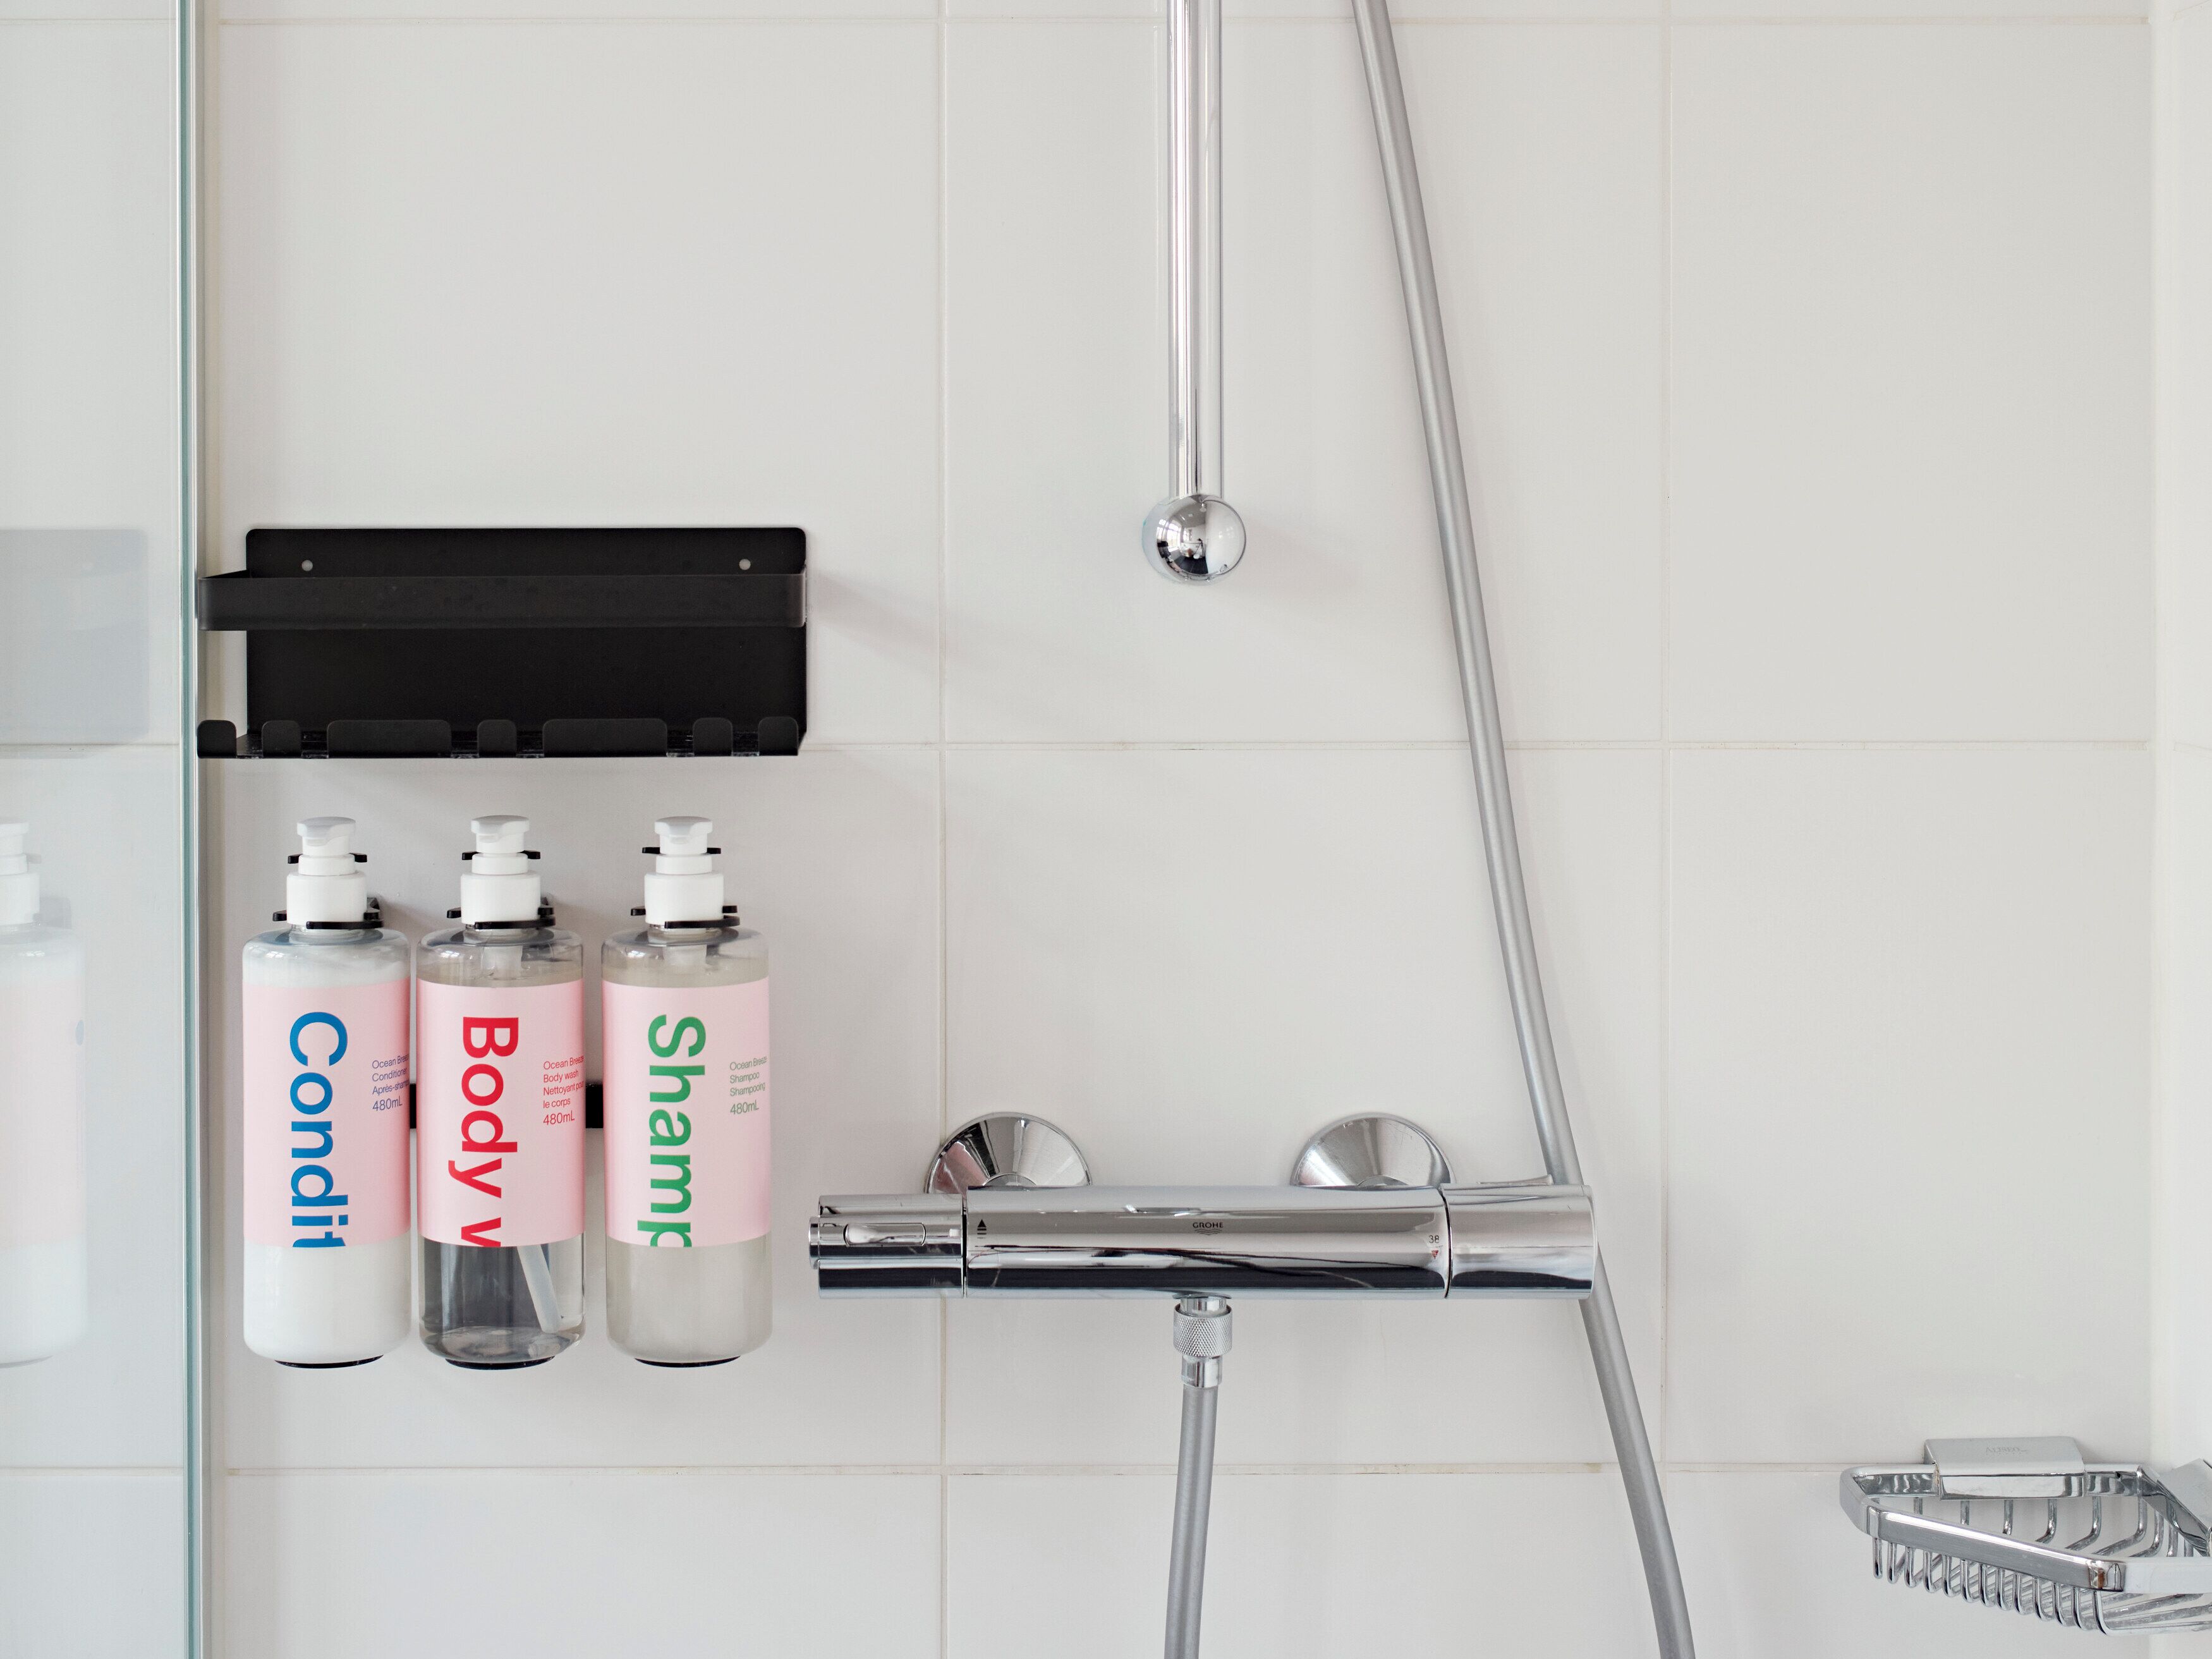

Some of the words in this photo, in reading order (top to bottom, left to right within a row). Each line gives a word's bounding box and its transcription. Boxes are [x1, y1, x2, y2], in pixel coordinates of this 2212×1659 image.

[372, 1059, 396, 1069] Ocean
[543, 1060, 568, 1070] Ocean
[729, 1061, 753, 1071] Ocean
[372, 1067, 408, 1082] Conditioner
[543, 1072, 563, 1083] Body
[564, 1069, 579, 1080] wash
[729, 1072, 760, 1084] Shampoo
[543, 1083, 576, 1096] Nettoyant
[729, 1081, 766, 1097] Shampooing
[372, 1095, 403, 1112] 480mL
[448, 1016, 519, 1198] Body
[543, 1100, 550, 1109] le
[551, 1097, 571, 1108] corps
[729, 1099, 760, 1115] 480mL
[542, 1109, 576, 1126] 480mL
[1192, 1221, 1224, 1229] GROHE
[1428, 1234, 1440, 1244] 38
